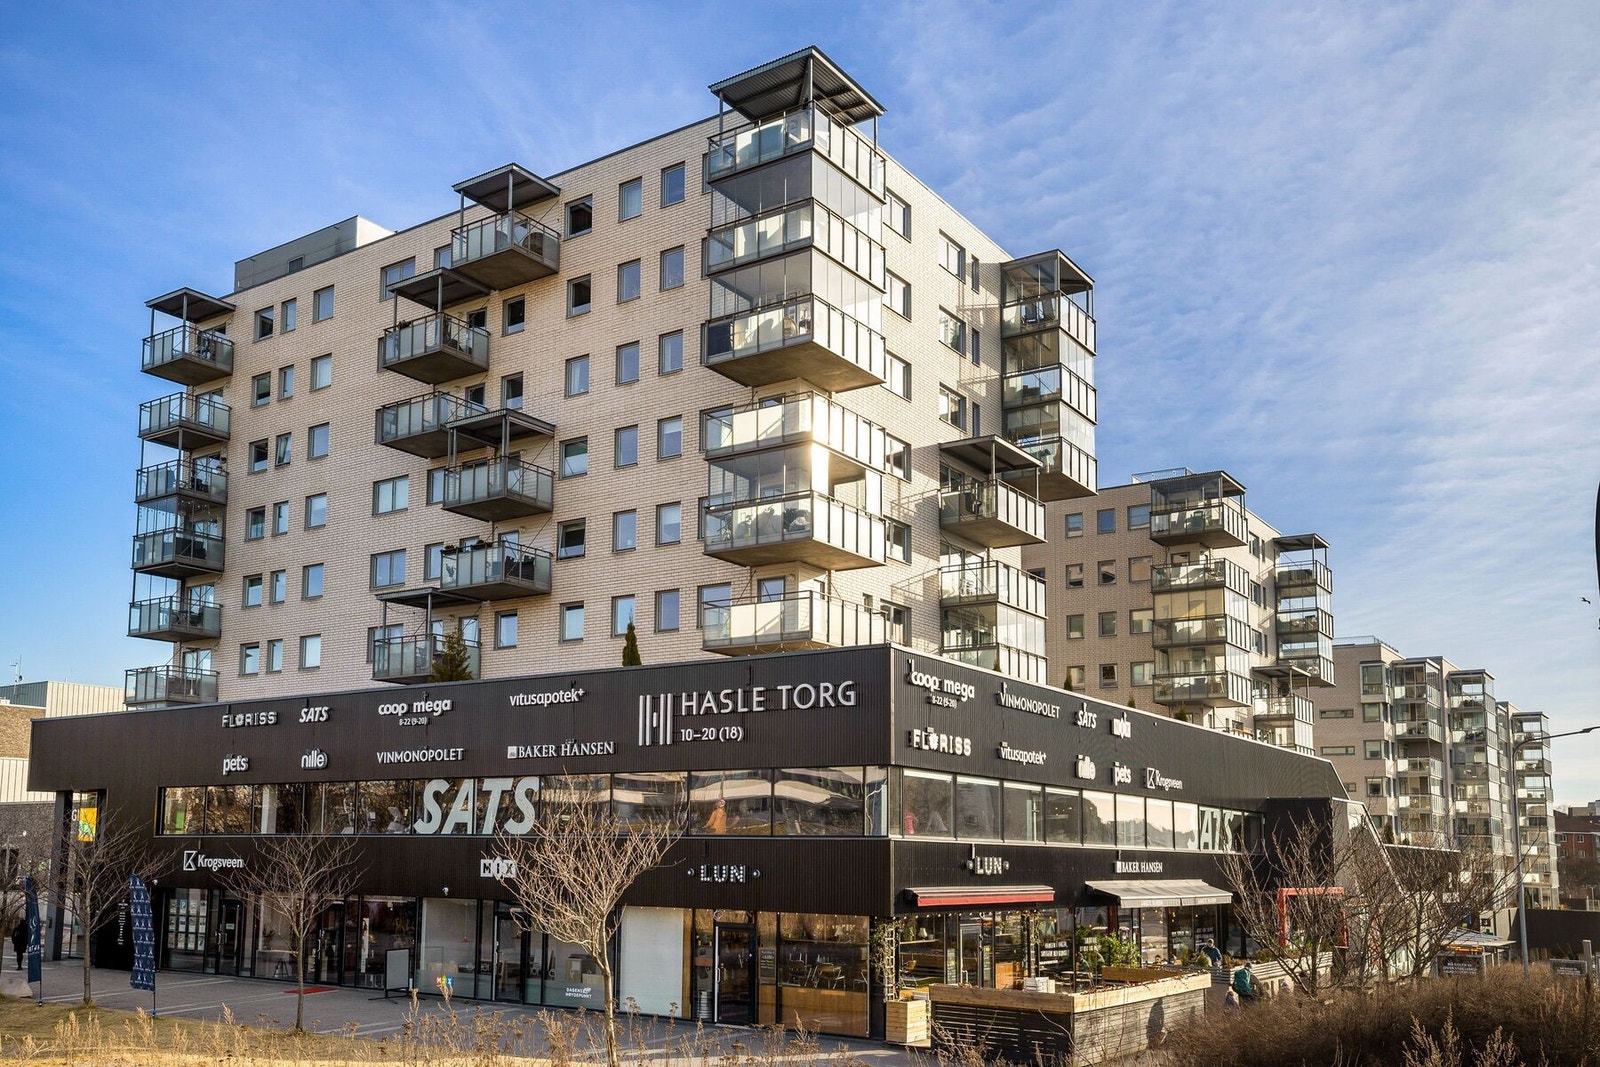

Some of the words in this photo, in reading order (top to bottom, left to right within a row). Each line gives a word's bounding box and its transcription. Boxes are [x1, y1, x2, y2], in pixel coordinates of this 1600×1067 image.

[911, 671, 940, 692] coop
[944, 679, 975, 702] mega
[378, 702, 408, 716] coop
[412, 699, 452, 716] mega
[682, 687, 766, 716] HASLE
[777, 681, 857, 710] TORG
[1000, 692, 1060, 719] VINMONOPOLET
[299, 706, 330, 723] SATS
[399, 718, 411, 726] 8-22
[1077, 710, 1097, 729] SATS
[719, 726, 744, 742] (18)
[301, 748, 327, 769] nille
[376, 748, 464, 764] VINMONOPOLET
[518, 744, 557, 758] BAKER
[560, 741, 615, 756] HANSEN
[222, 753, 249, 775] pets
[1115, 765, 1131, 786] pets
[413, 776, 540, 835] SATS
[197, 854, 245, 872] Krogsveen
[975, 856, 1002, 876] LUN
[1121, 861, 1140, 873] BAKER
[1141, 861, 1163, 873] HANSEN
[700, 863, 746, 883] LUN
